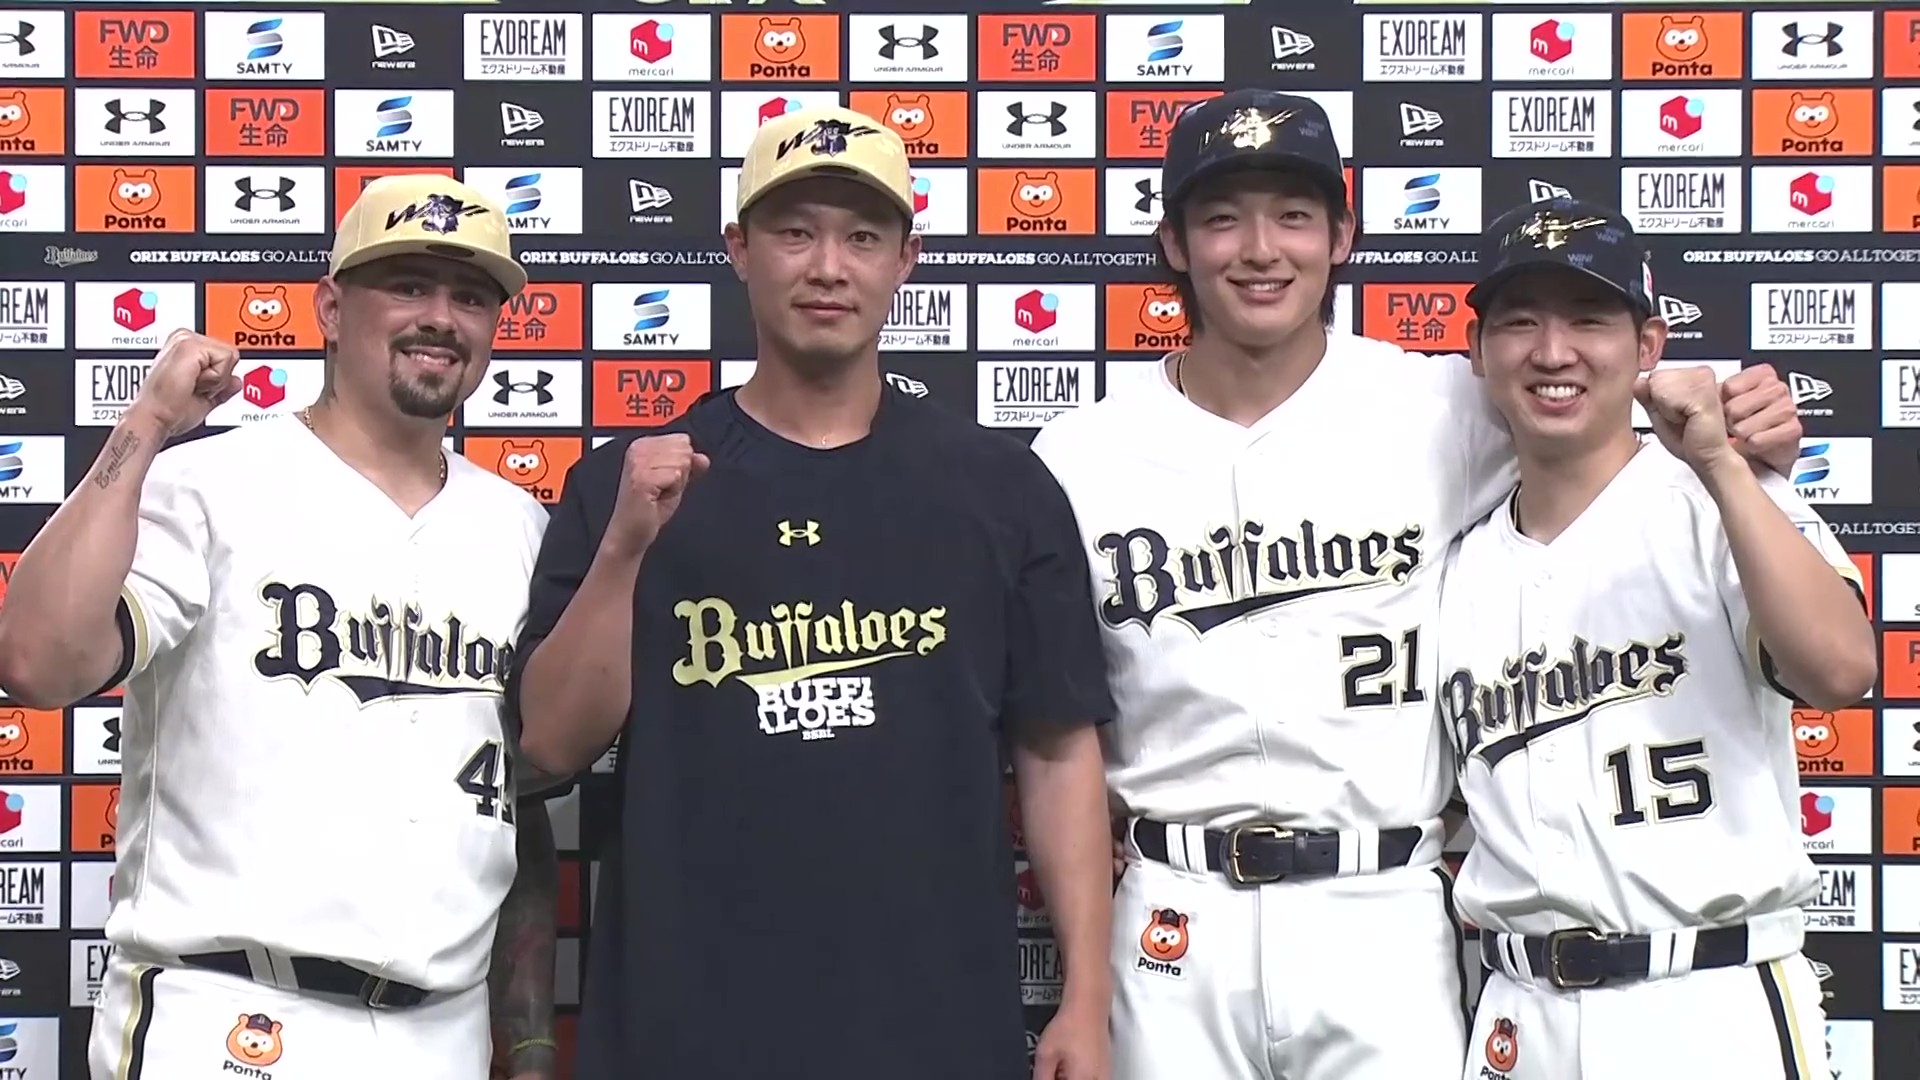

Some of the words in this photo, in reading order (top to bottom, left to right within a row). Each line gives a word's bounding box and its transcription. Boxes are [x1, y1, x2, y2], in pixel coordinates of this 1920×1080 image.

[100, 20, 169, 43] FWD
[481, 20, 565, 56] EXDREAM
[1003, 23, 1071, 47] FWD
[1380, 20, 1465, 56] EXDREAM
[109, 45, 158, 69] 生命
[1011, 48, 1060, 72] 生命
[237, 62, 292, 74] SAMTY
[628, 67, 674, 77] mercari
[750, 63, 812, 79] Ponta
[1137, 65, 1192, 76] SAMTY
[1528, 66, 1574, 76] mercari
[1651, 62, 1713, 78] Ponta
[231, 98, 299, 121] FWD
[609, 97, 694, 132] EXDREAM
[1509, 97, 1594, 132] EXDREAM
[239, 123, 288, 147] 生命
[1139, 124, 1165, 148] 生
[366, 140, 421, 152] SAMTY
[905, 140, 939, 155] nta
[1658, 143, 1704, 153] mercari
[1781, 138, 1843, 154] Ponta
[1639, 173, 1724, 208] EXDREAM
[104, 214, 166, 230] Ponta
[1006, 217, 1068, 233] Ponta
[1394, 218, 1449, 229] SAMTY
[1788, 219, 1834, 229] mercari
[130, 250, 168, 263] ORIX
[171, 250, 260, 263] BUFFALOES
[520, 251, 557, 264] ORIX
[560, 251, 649, 264] BUFFALOES
[917, 252, 945, 264] RIX
[946, 252, 1035, 265] BUFFALOES
[1683, 249, 1722, 263] ORIX
[1724, 249, 1814, 263] BUFFALOES
[498, 292, 558, 315] WD
[1388, 293, 1456, 316] FWD
[1769, 289, 1855, 325] EXDREAM
[234, 331, 296, 347] Ponta
[624, 333, 679, 345] SAMTY
[1397, 315, 1446, 342] 生命
[112, 336, 158, 346] mercari
[1012, 337, 1058, 347] mercari
[618, 369, 686, 393] FWD
[994, 367, 1079, 402] EXDREAM
[626, 396, 676, 419] 生命
[1095, 517, 1425, 638] Buffaloes
[672, 597, 947, 688] Buffaloes
[1338, 624, 1428, 710] 21
[1440, 632, 1690, 777] Buffaloes
[1603, 737, 1717, 829] 15
[1138, 957, 1181, 977] Ponta
[223, 1060, 272, 1080] Ponta
